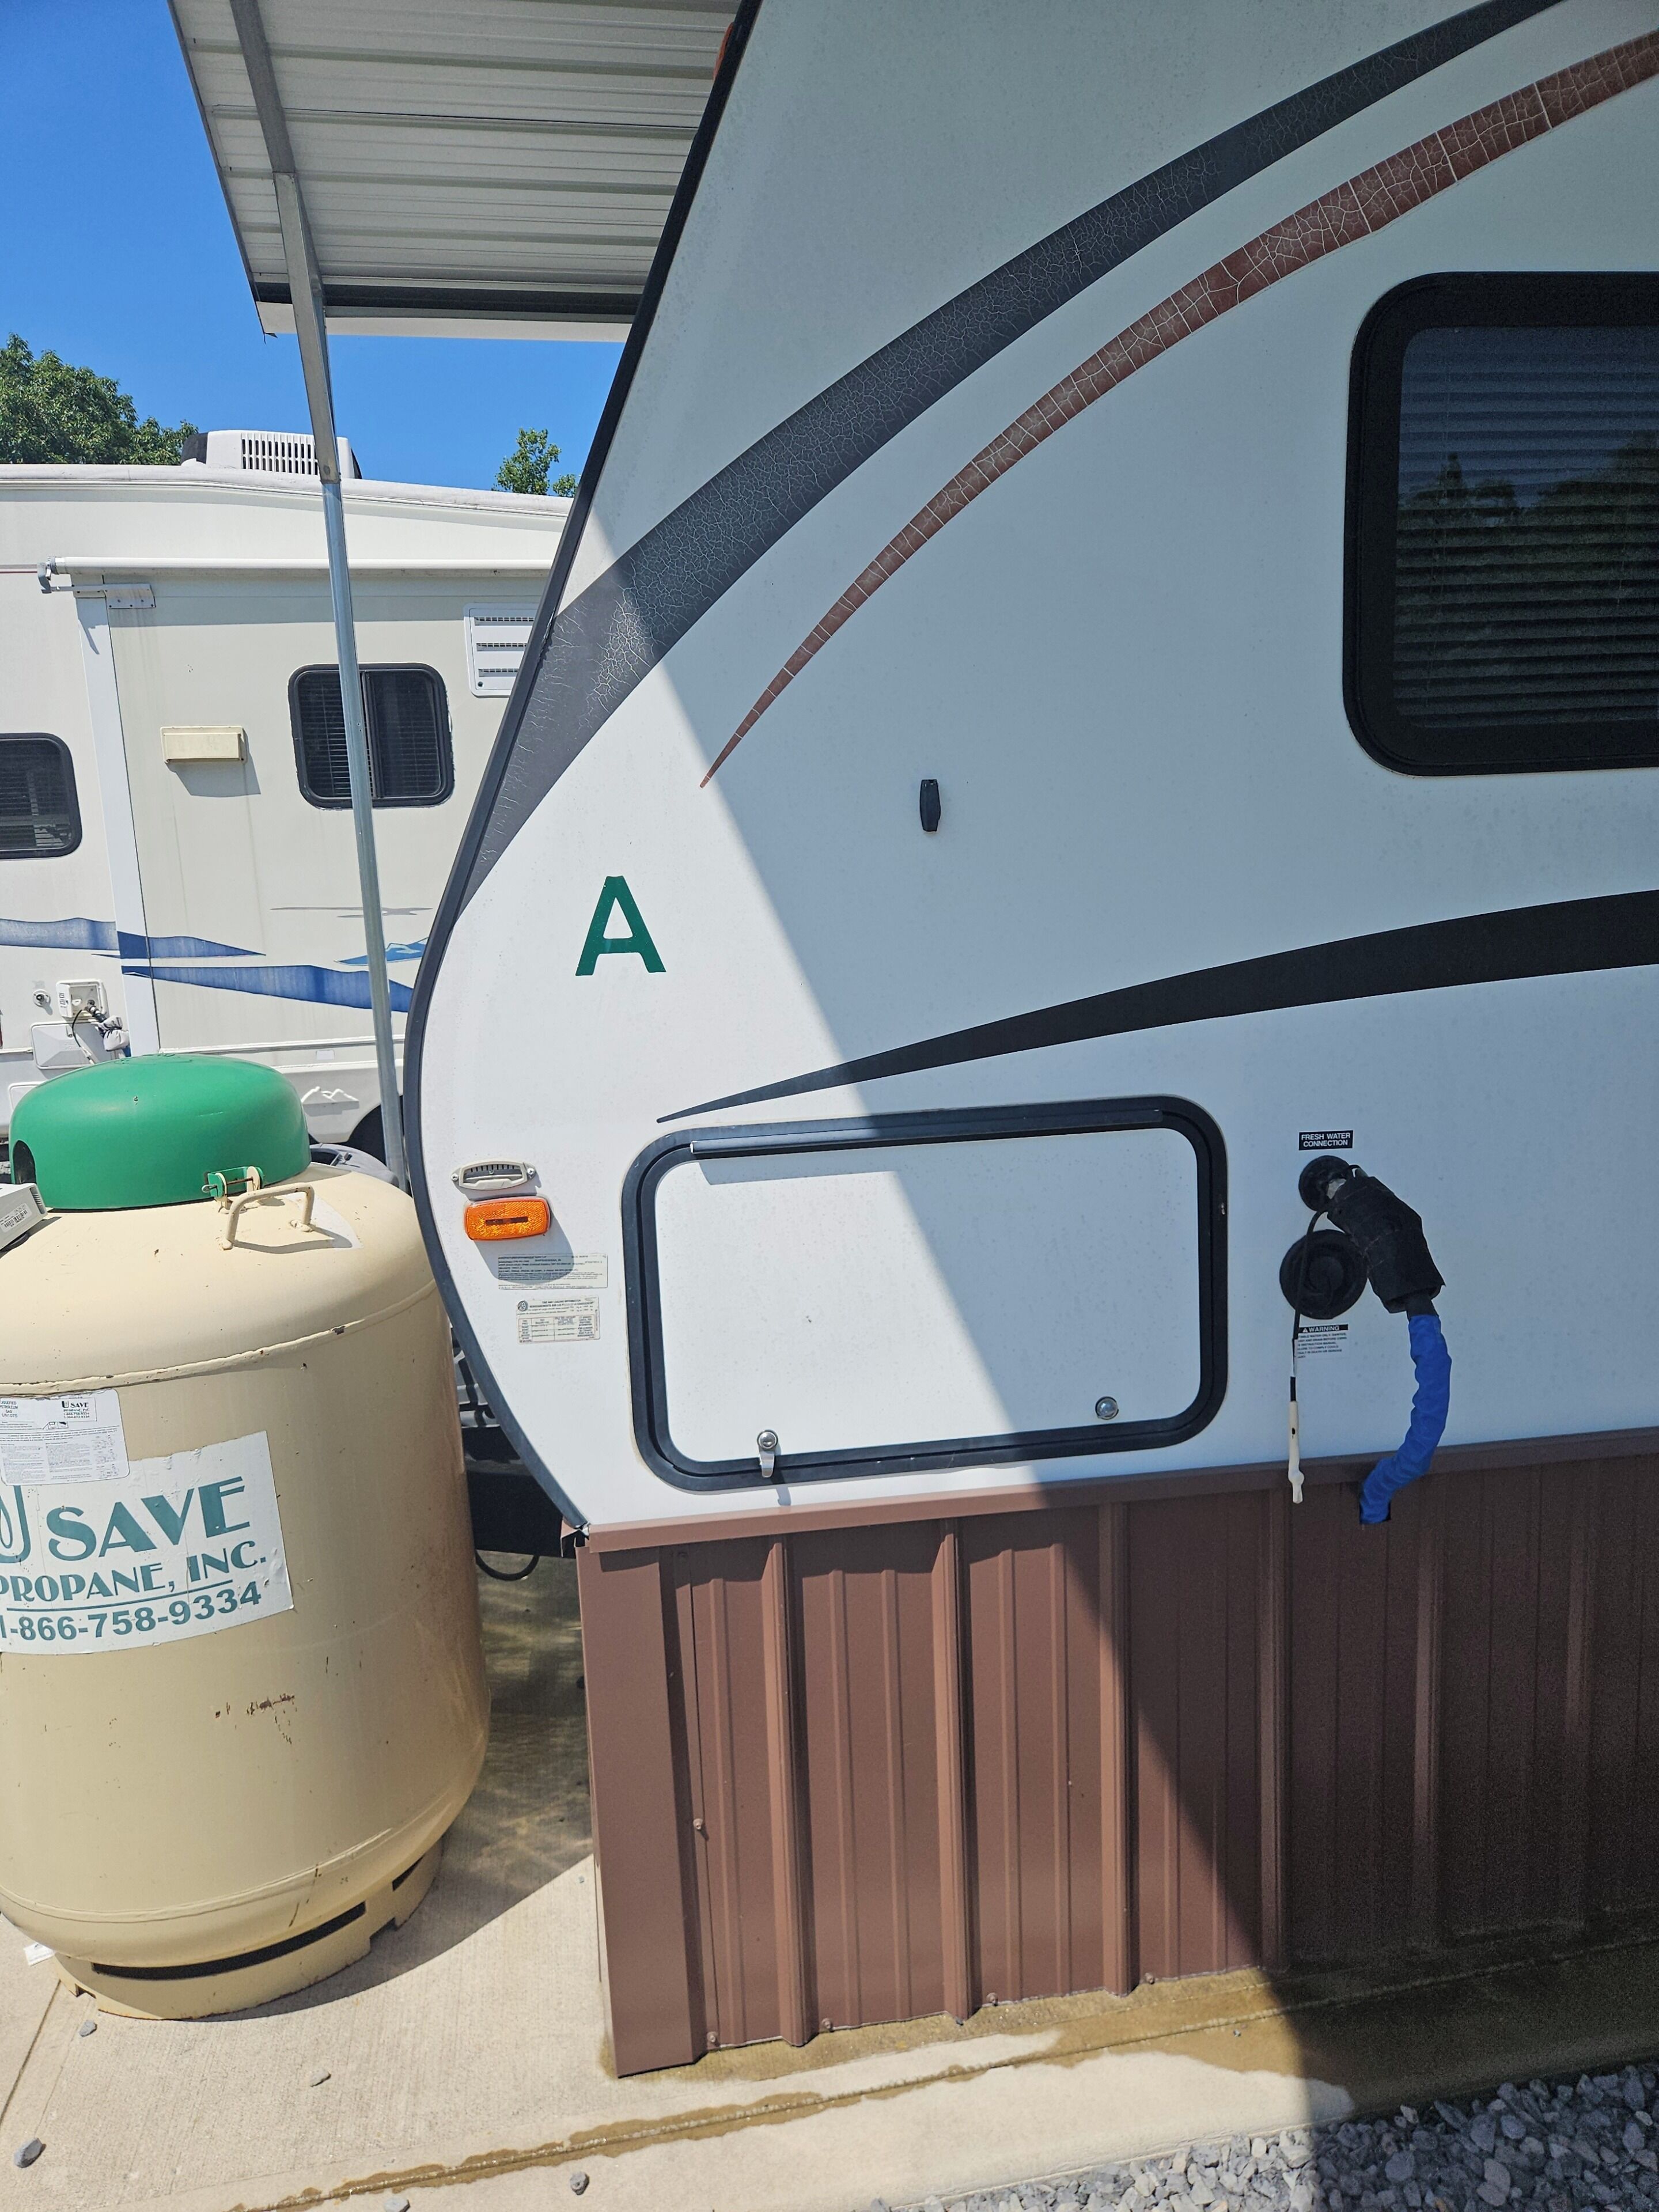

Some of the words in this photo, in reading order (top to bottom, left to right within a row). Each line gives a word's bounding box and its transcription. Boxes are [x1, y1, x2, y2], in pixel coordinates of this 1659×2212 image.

[575, 876, 666, 976] A
[46, 1476, 250, 1561] SAVE
[186, 1540, 267, 1582] INC.
